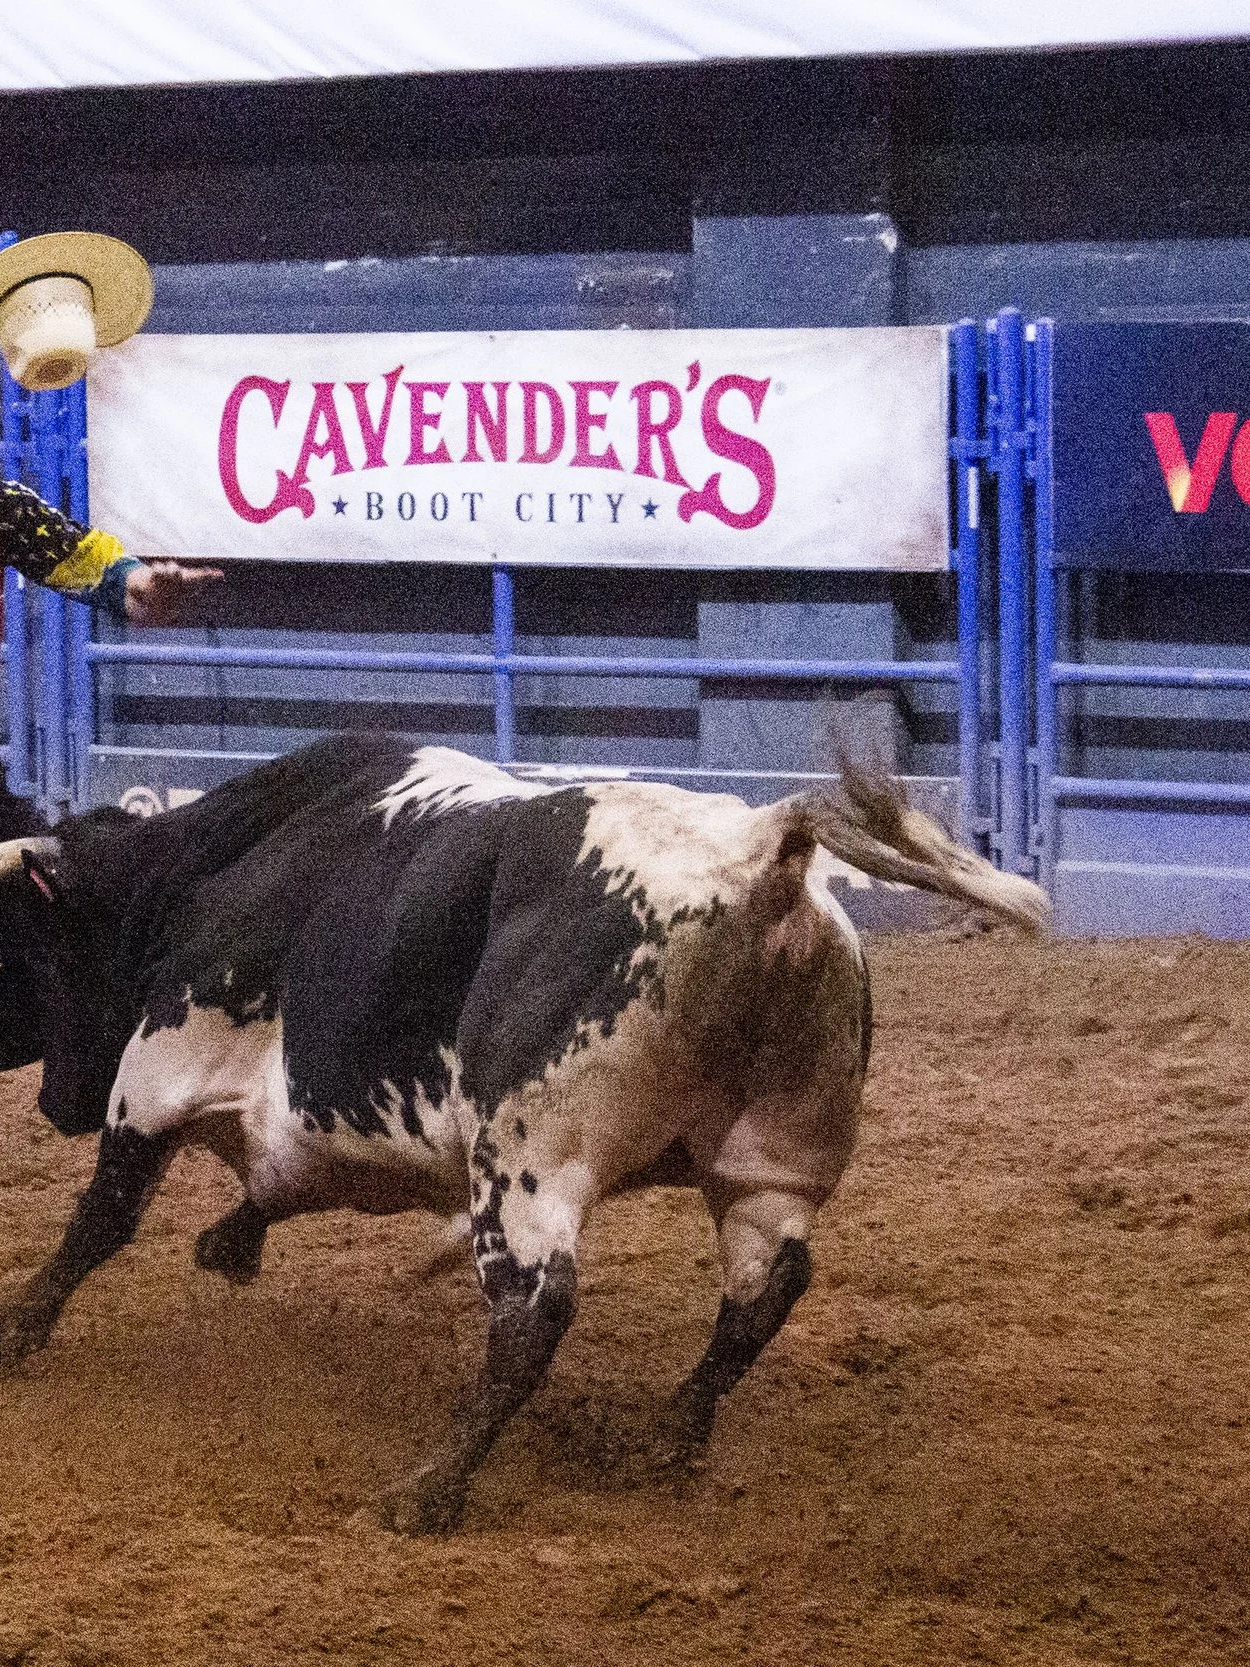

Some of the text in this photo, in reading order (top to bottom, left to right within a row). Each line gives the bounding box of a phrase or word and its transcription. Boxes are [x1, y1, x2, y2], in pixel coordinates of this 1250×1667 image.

[217, 360, 777, 530] CAVENDER'S
[1144, 411, 1250, 514] V
[364, 491, 624, 523] BOOT CITY
